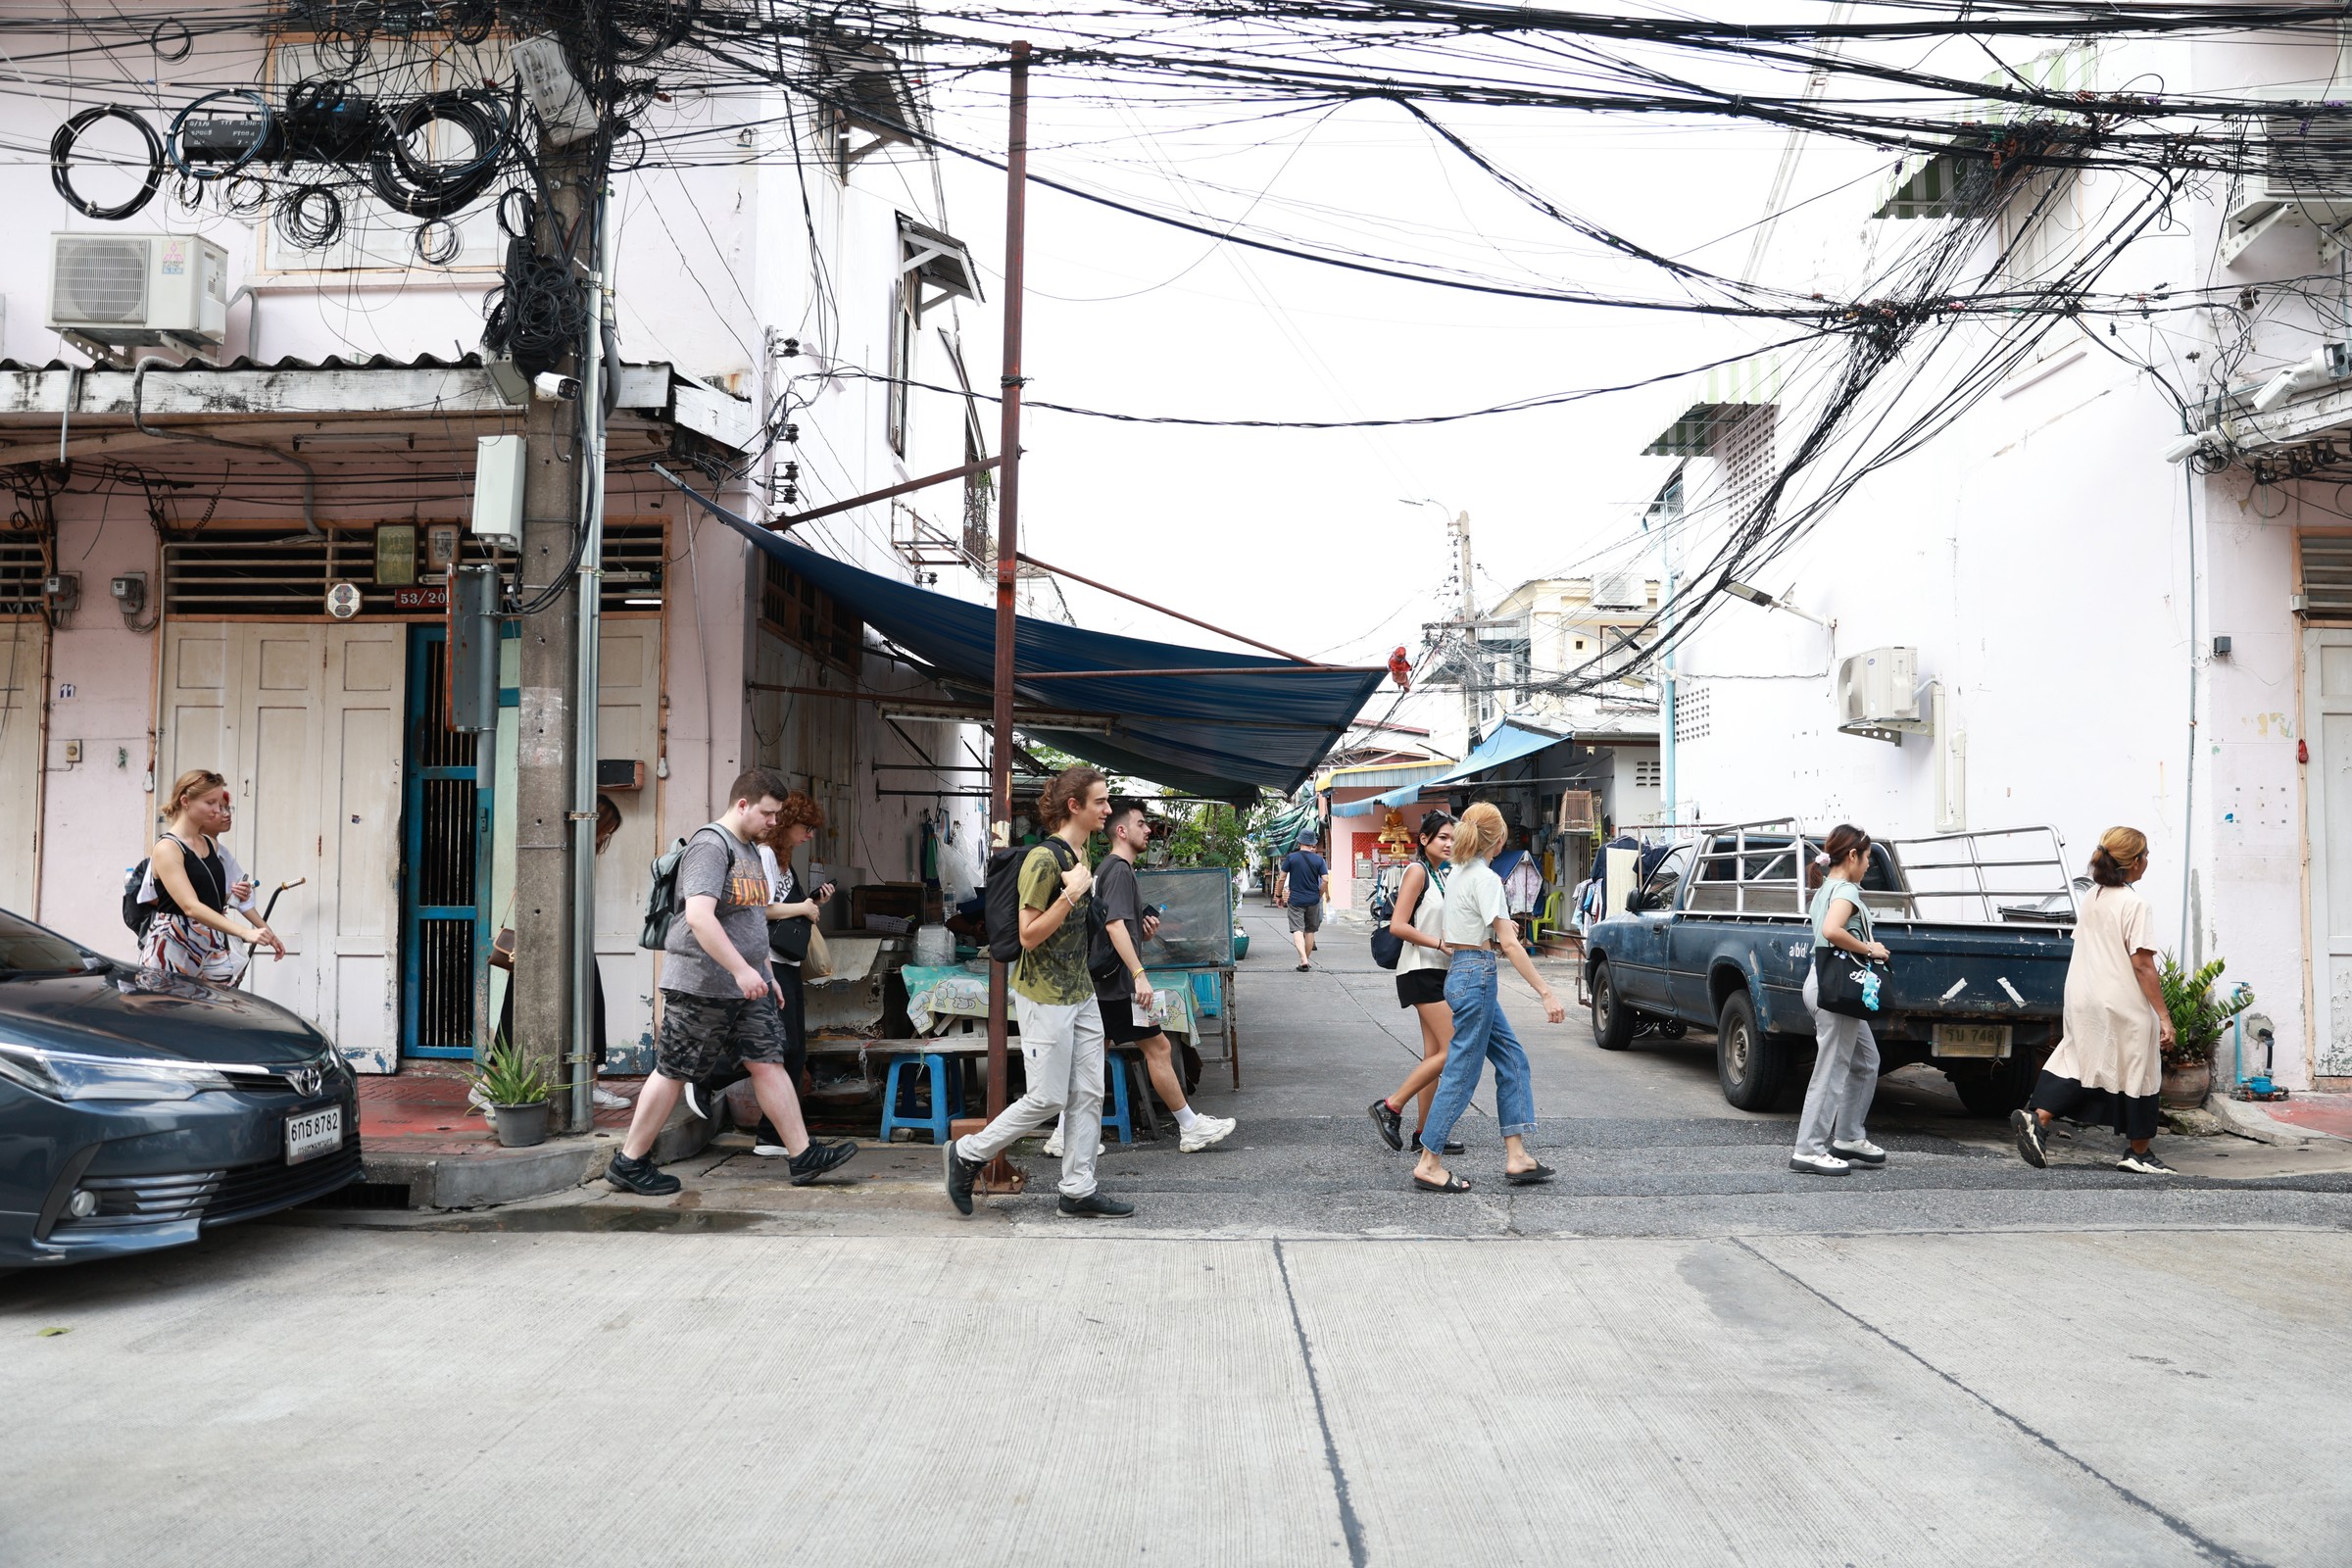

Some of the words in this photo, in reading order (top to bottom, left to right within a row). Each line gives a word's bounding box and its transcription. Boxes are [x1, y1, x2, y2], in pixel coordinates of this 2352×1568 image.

[400, 589, 446, 606] 53/20
[291, 1119, 313, 1142] 6กธ
[314, 1112, 338, 1135] 8782
